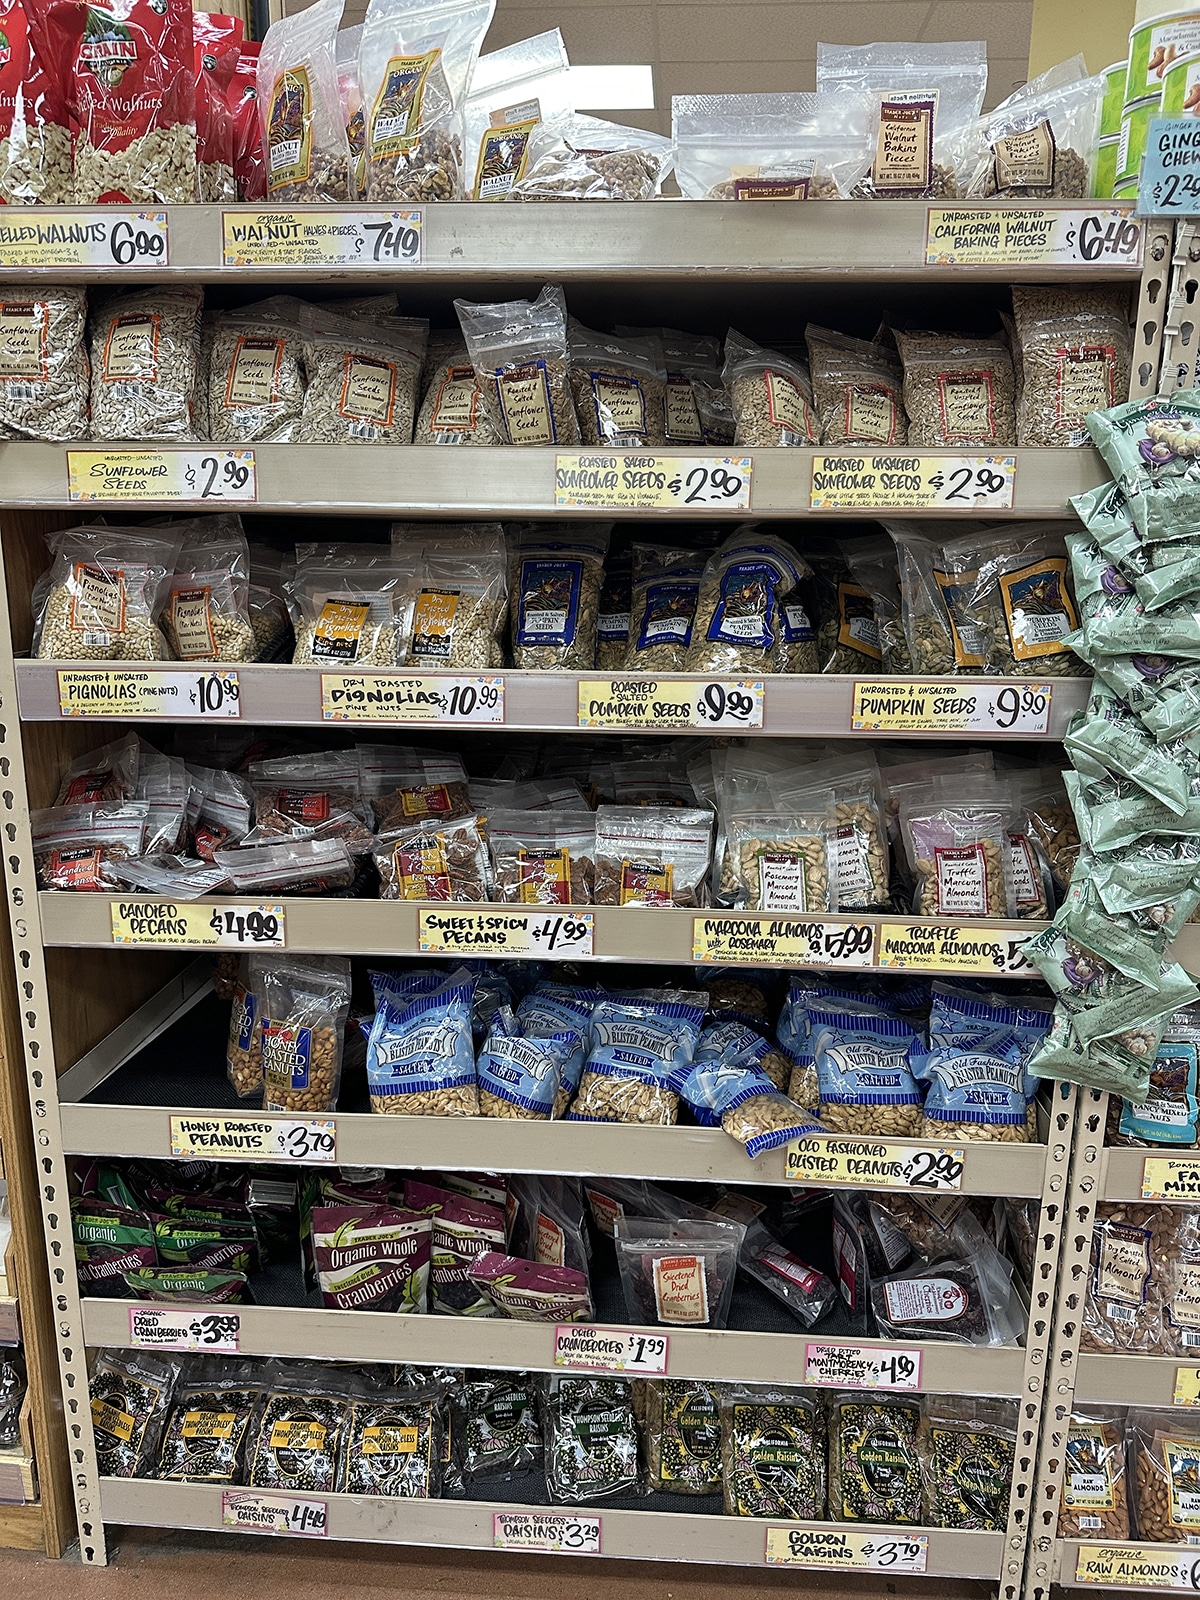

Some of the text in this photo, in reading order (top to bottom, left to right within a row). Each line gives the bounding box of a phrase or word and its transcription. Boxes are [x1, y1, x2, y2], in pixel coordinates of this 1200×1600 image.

[111, 95, 162, 112] Walnuts
[886, 124, 916, 132] California
[885, 132, 917, 142] Walnut
[272, 141, 299, 156] WALNUT
[884, 142, 917, 153] Baking
[886, 153, 915, 162] Pieces
[482, 175, 513, 187] WALNUT
[256, 214, 295, 225] organic
[942, 211, 1044, 222] UNROASTED UNSALTED
[37, 223, 106, 243] WALNUTS
[232, 223, 302, 241] WALNUT
[935, 219, 1058, 238] CALIFORNIA WALNUT
[954, 234, 1046, 249] BAKING PIECES
[507, 406, 545, 419] Sunflower
[516, 418, 539, 430] Seeds
[578, 456, 655, 469] ROASTED SALTED
[823, 457, 920, 472] ROASTED UNSALTED
[90, 464, 168, 478] SUNFLOWER
[102, 478, 147, 490] SEEDS
[556, 469, 618, 490] SUNFLOWER
[622, 470, 666, 490] SEEDS
[814, 472, 876, 490] SUNFLOWER
[880, 474, 921, 490] SEEDS
[431, 594, 444, 603] Dry
[177, 605, 205, 618] Pignolias
[339, 604, 353, 615] Dry
[63, 674, 104, 682] UNROASTED
[343, 679, 423, 688] DRY TOASTED
[68, 684, 136, 700] PIGNOLIAS
[611, 682, 657, 694] ROASTED
[860, 686, 957, 695] UNROASTED UNSALTED
[616, 693, 648, 701] SALTED
[589, 700, 648, 717] PUMPKIN
[652, 701, 691, 717] SEEDS
[860, 697, 925, 716] PUMPKIN
[932, 697, 977, 715] SEEDS
[57, 862, 95, 877] Candied
[947, 867, 977, 877] Truffle
[766, 881, 799, 891] Marcona
[946, 887, 980, 898] Almonds
[769, 892, 797, 901] Almonds
[119, 903, 178, 920] CANDIED
[130, 918, 187, 936] PECANS
[425, 915, 528, 931] SWEET SPICY
[704, 920, 824, 940] MARCONA ALMONDS
[906, 926, 961, 941] TRUFFLE
[443, 930, 507, 944] PECANS
[728, 937, 777, 950] ROSEMARY
[885, 939, 935, 955] MARCONA
[939, 942, 1000, 958] ALMONDS
[265, 1035, 302, 1054] HONEY
[619, 1053, 649, 1065] SALTED
[1150, 1113, 1171, 1122] NUTS
[180, 1121, 272, 1133] HONEY ROASTED
[189, 1134, 263, 1148] PEANUTS
[798, 1139, 887, 1157] OLD FASHIONED
[788, 1153, 838, 1172] BLISTER
[846, 1158, 903, 1177] PEANUTS
[78, 1224, 117, 1242] Organic
[456, 1239, 492, 1253] Whole
[330, 1238, 418, 1268] Organic Whole
[1119, 1255, 1141, 1266] Salted
[1105, 1264, 1142, 1281] Almonds
[336, 1262, 413, 1310] Cranberries
[134, 1316, 159, 1326] DRIED
[134, 1327, 188, 1338] CRANBERRIES
[572, 1329, 596, 1338] DRIED
[558, 1336, 624, 1354] CRANBERRIES
[807, 1358, 874, 1371] MONTMORENCY
[820, 1368, 865, 1378] CHERRIES
[493, 1401, 513, 1411] RAISINS
[273, 1430, 300, 1438] THOMPSON
[589, 1423, 609, 1432] RAISINS
[365, 1435, 392, 1443] THOMPSON
[752, 1452, 775, 1461] Golden
[860, 1452, 883, 1462] Golden
[238, 1512, 275, 1523] RAISINS
[504, 1524, 558, 1540] RAISINS
[788, 1544, 853, 1558] RAISINS
[1098, 1548, 1144, 1563] organic
[1086, 1561, 1178, 1578] RAW ALMONDS
